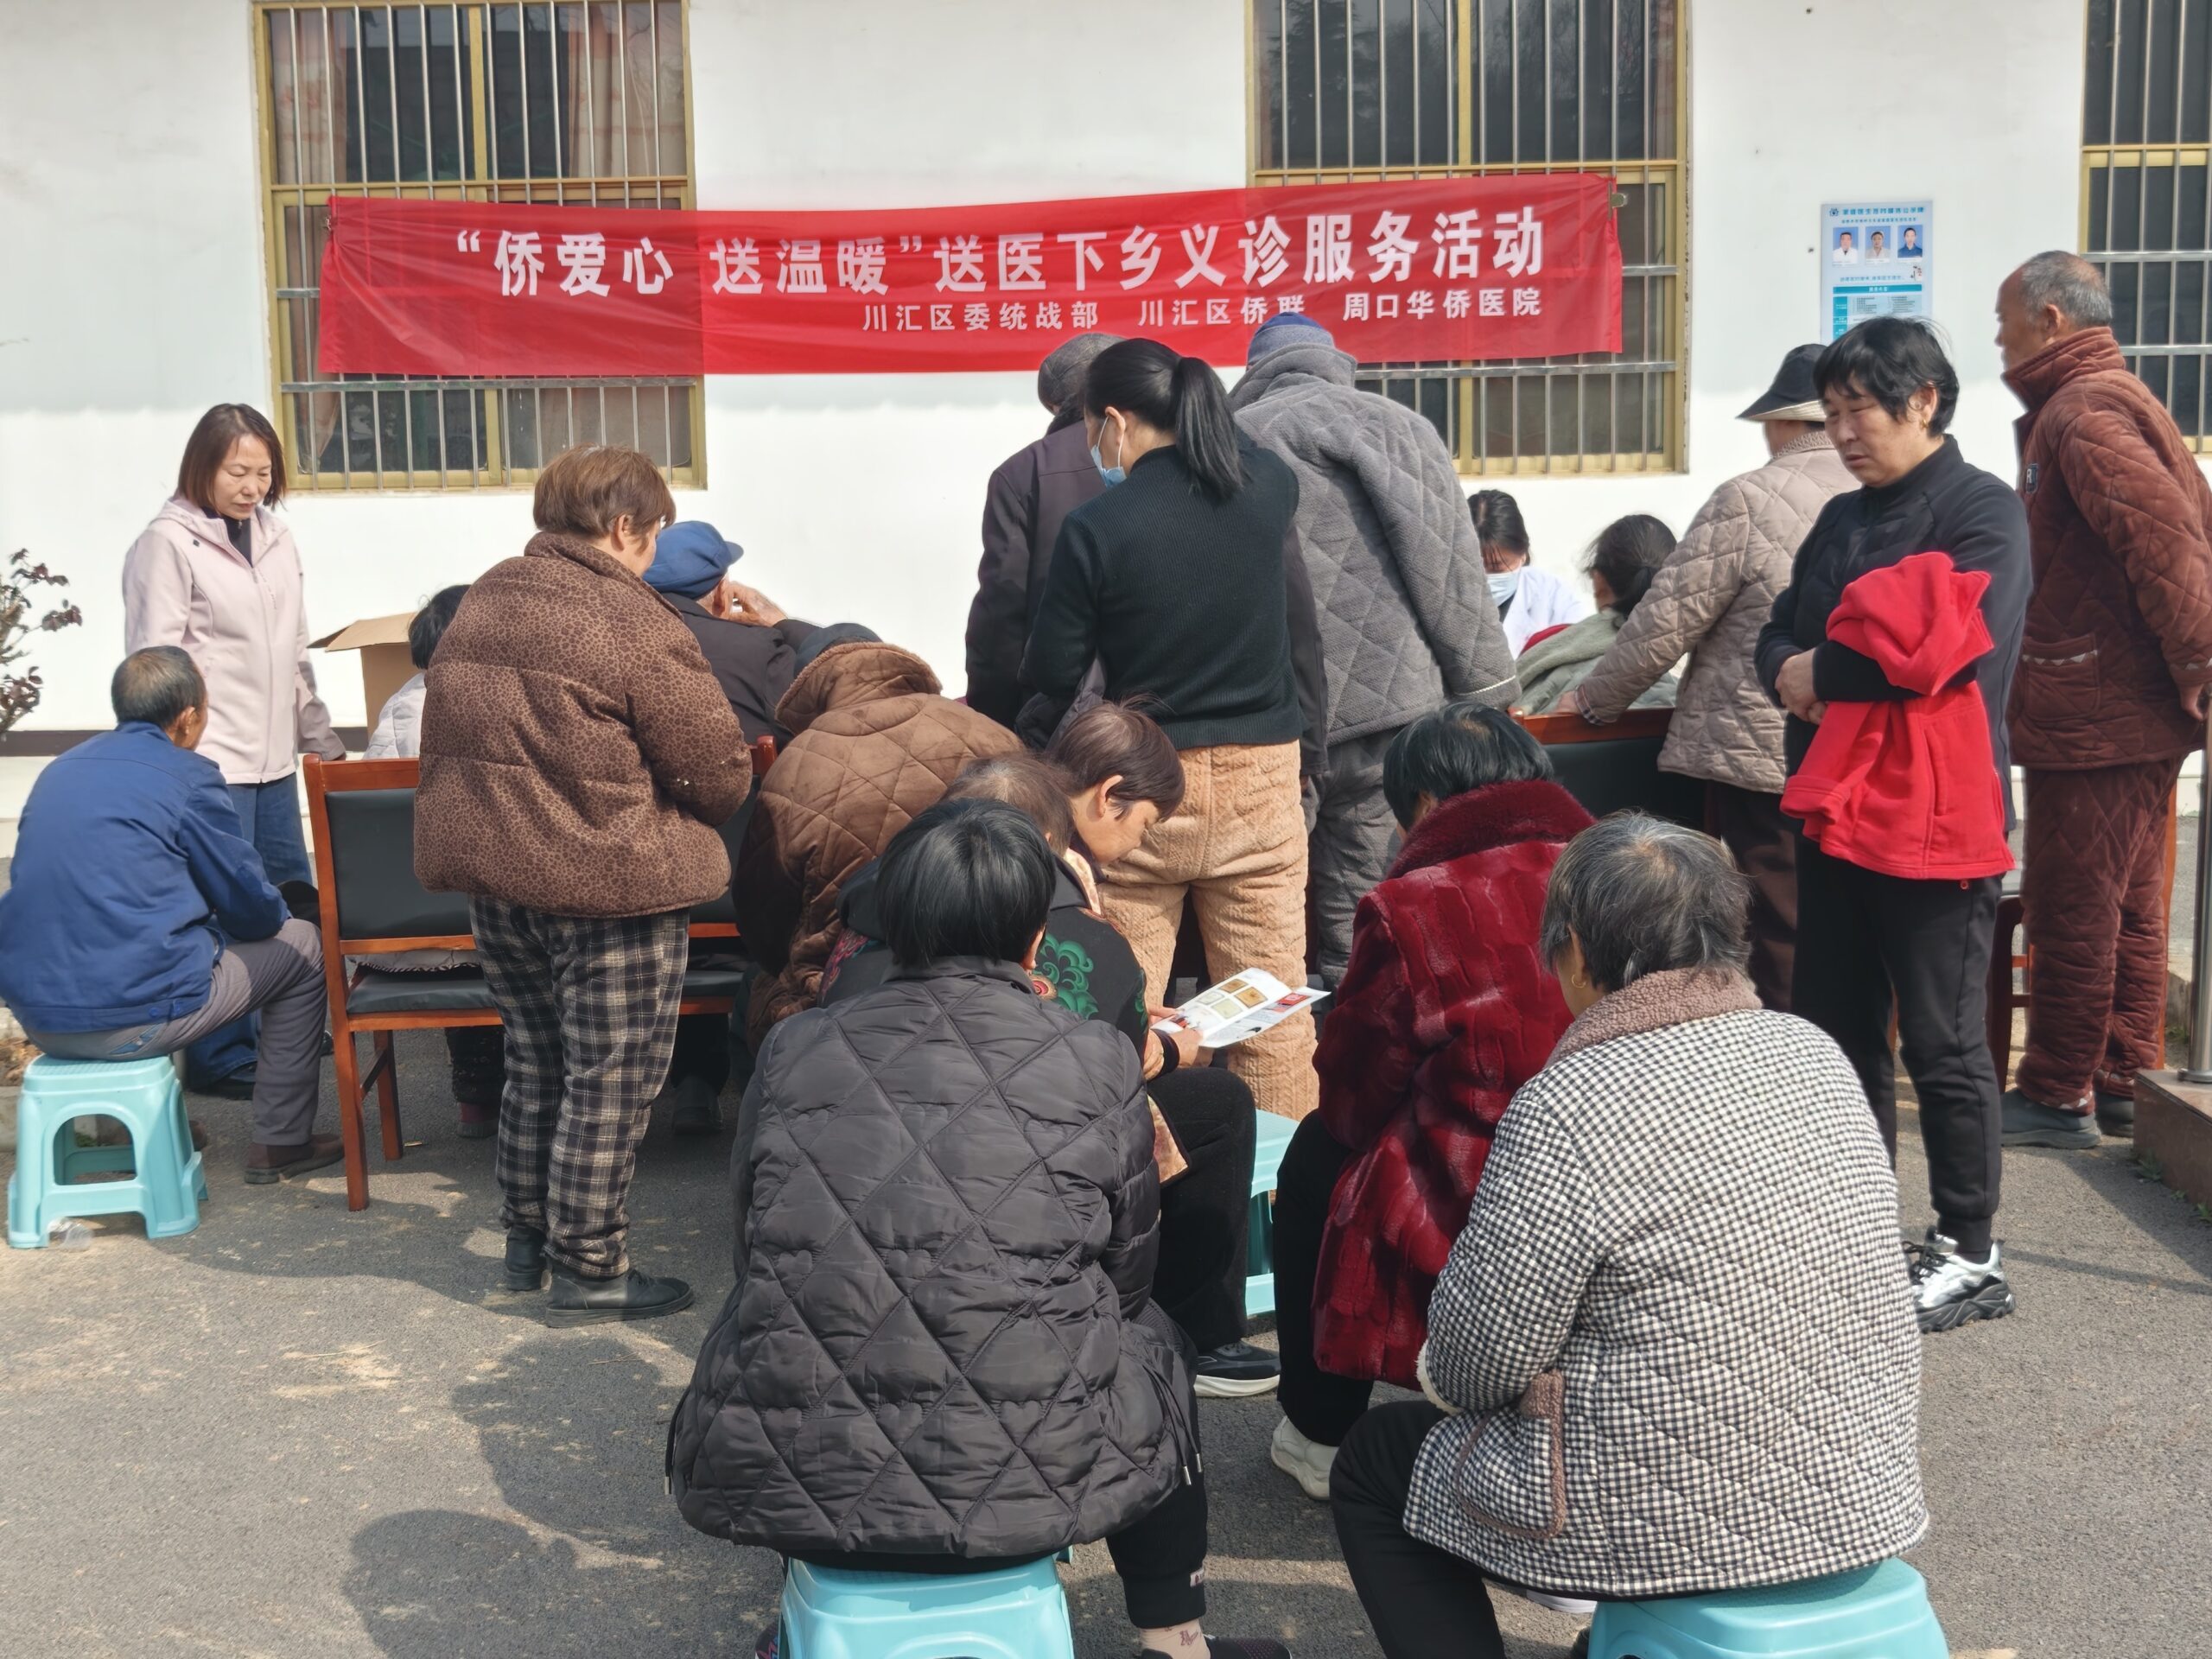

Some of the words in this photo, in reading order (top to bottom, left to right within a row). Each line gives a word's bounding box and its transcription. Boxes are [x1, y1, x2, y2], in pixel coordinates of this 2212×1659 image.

[862, 301, 1099, 332] 川汇区委统战部
[1343, 287, 1542, 322] 周口华侨医院
